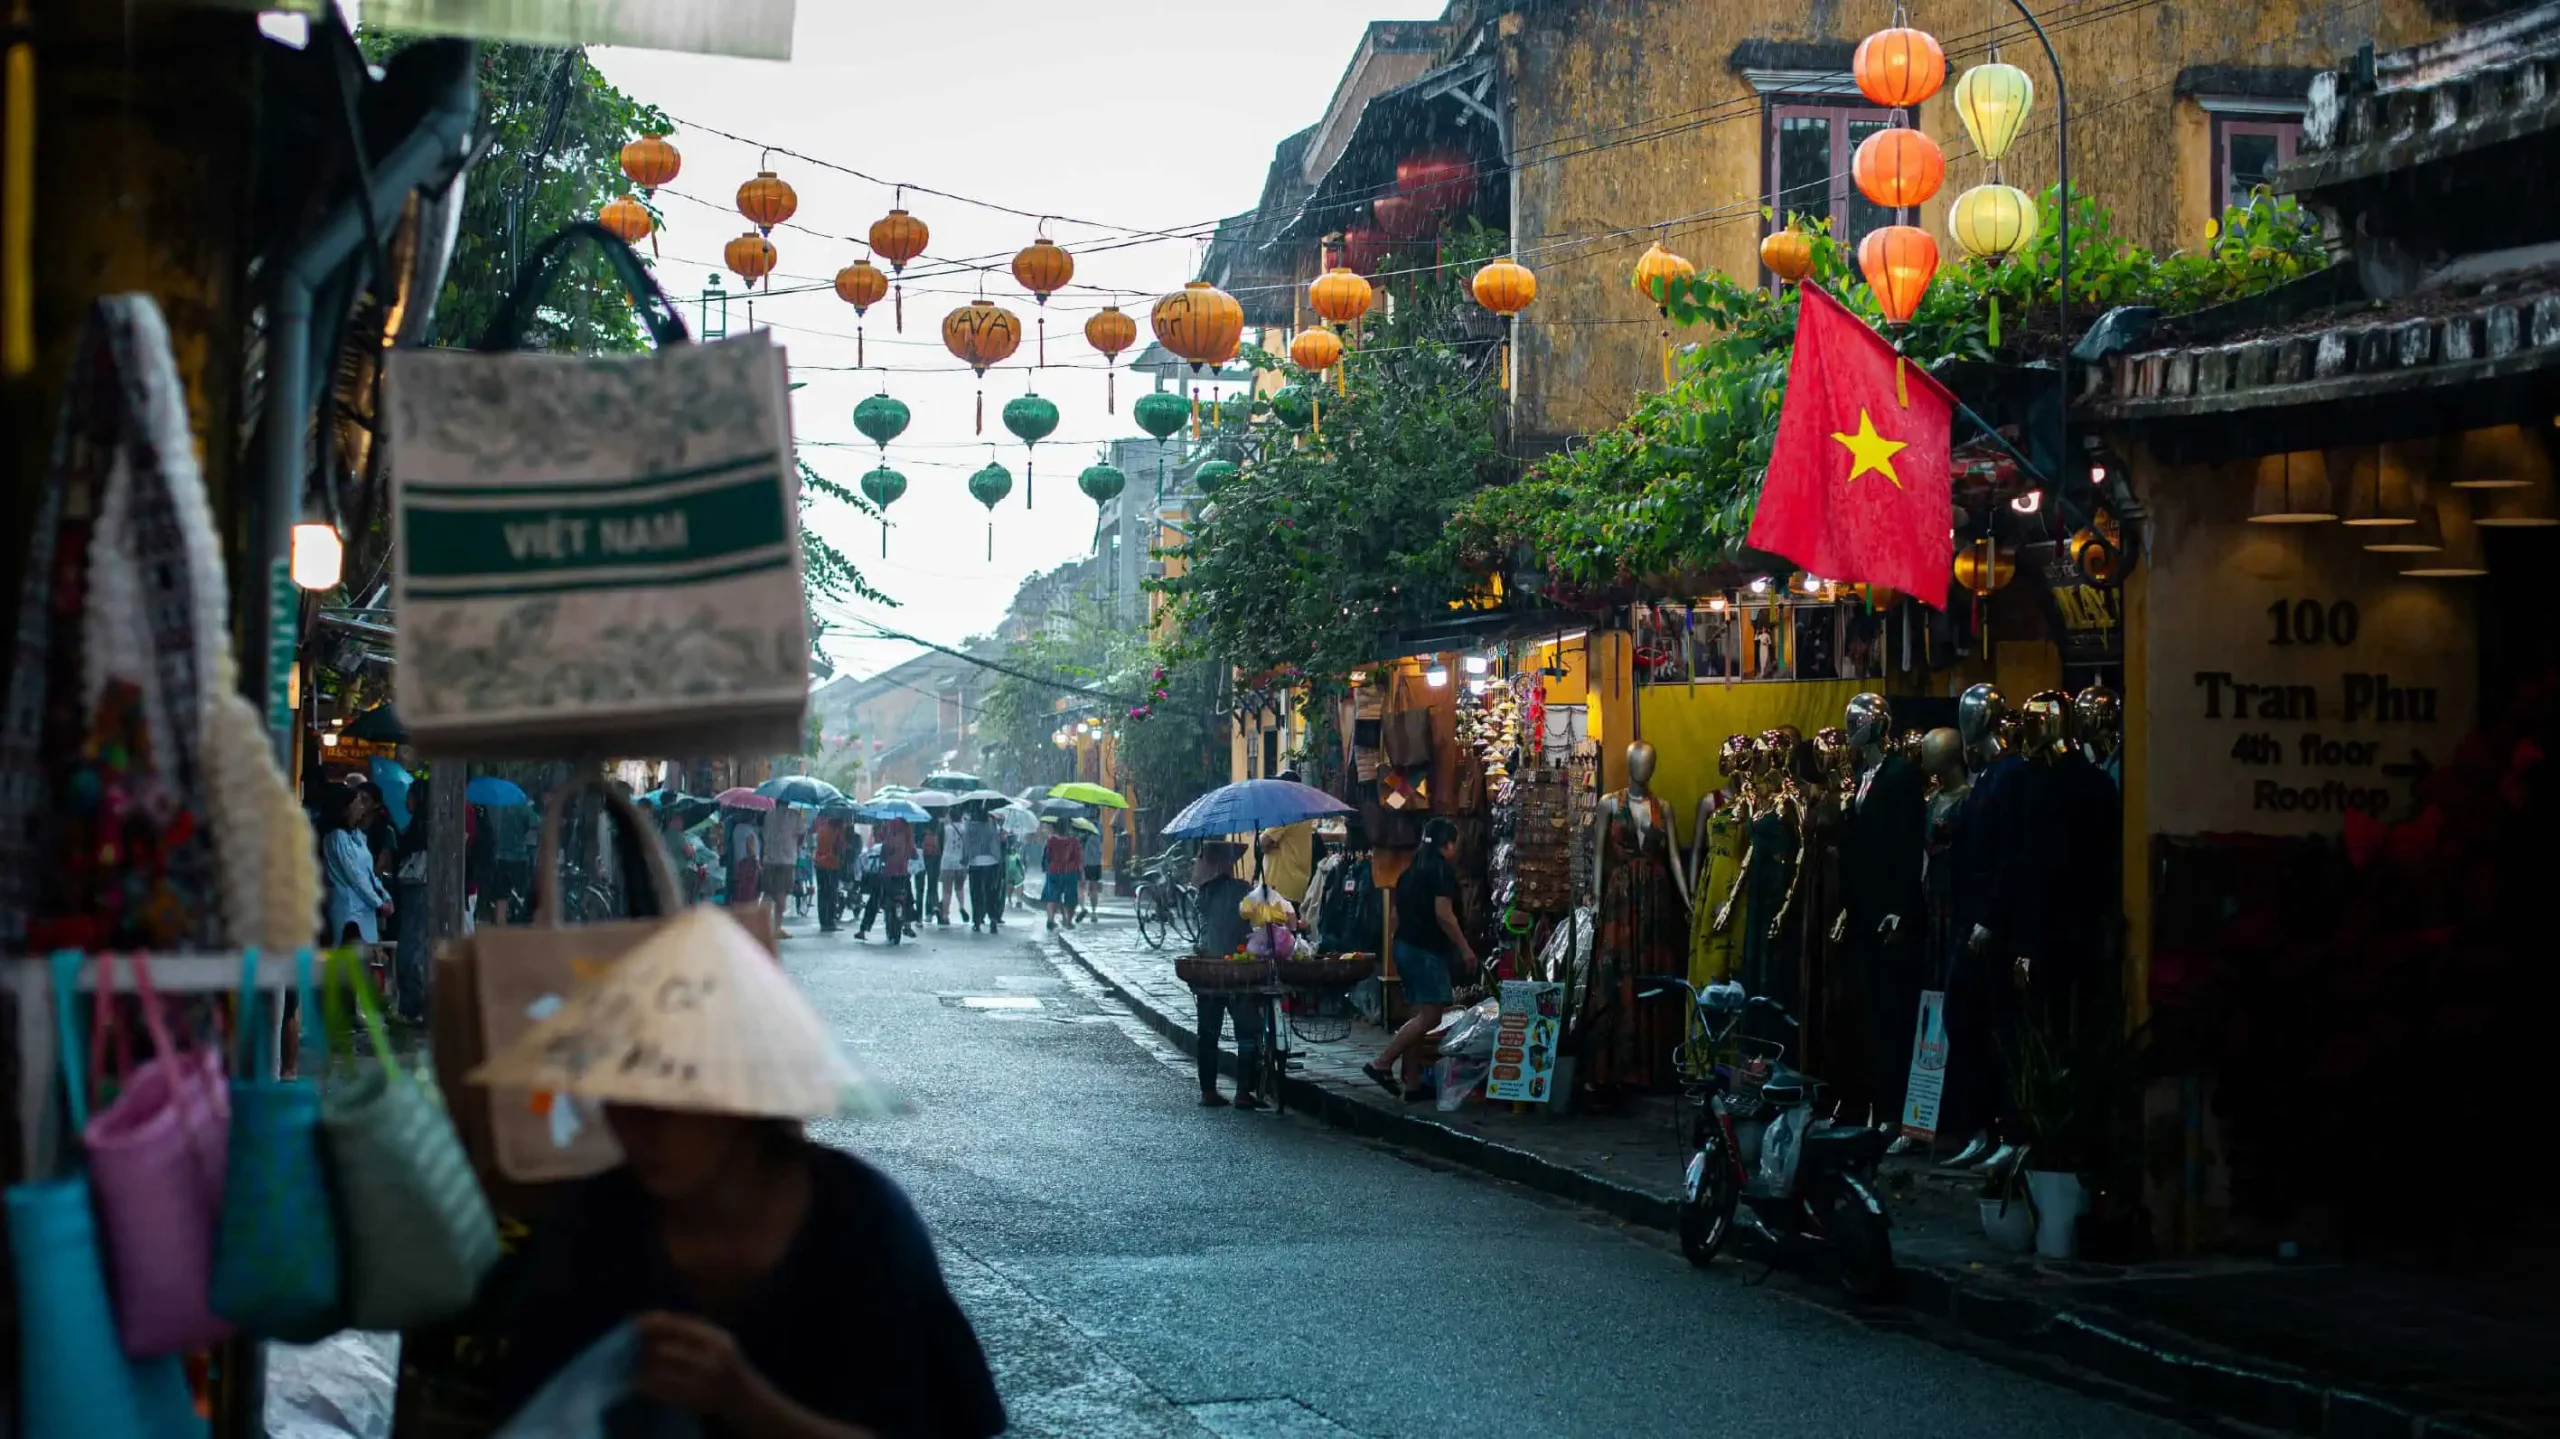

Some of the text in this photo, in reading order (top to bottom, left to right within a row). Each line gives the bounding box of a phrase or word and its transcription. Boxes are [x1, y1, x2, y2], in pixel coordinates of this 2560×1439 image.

[600, 510, 688, 554] NAM
[2267, 598, 2360, 647] 100
[2194, 671, 2438, 722] Tran Phu
[2231, 732, 2380, 766] 4th floor
[2253, 779, 2390, 818] Rooftop
